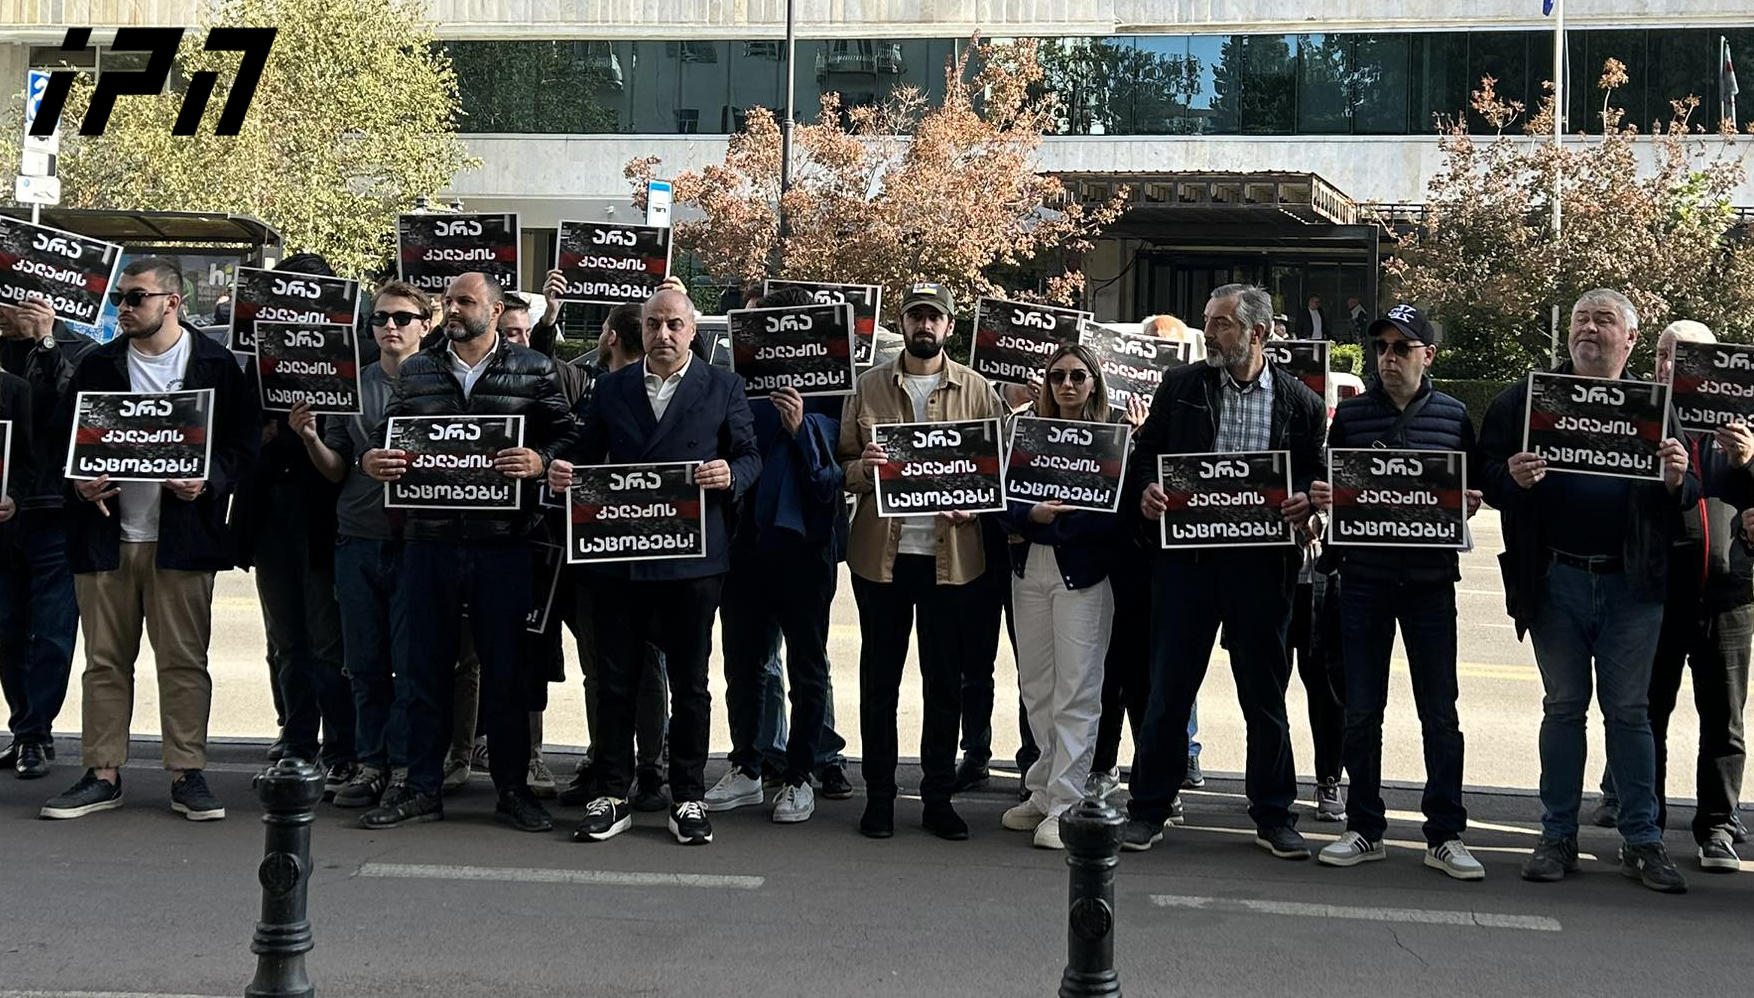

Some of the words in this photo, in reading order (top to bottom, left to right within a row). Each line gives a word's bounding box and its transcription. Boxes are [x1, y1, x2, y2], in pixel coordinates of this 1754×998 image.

[434, 220, 483, 237] არა
[592, 229, 637, 247] არა
[32, 232, 83, 259] არა
[423, 248, 496, 261] კალაძის
[12, 258, 87, 287] კალაძის
[578, 255, 647, 272] კალაძის
[271, 278, 321, 299] არა
[765, 314, 813, 333] არა
[1011, 309, 1057, 331] არა
[284, 330, 325, 348] არა
[1112, 335, 1158, 359] არა
[755, 343, 828, 360] კალაძის
[275, 360, 337, 375] კალაძის
[266, 388, 353, 406] საცობებს!
[1571, 384, 1626, 407] არა
[119, 400, 173, 417] არა
[101, 428, 184, 444] კალაძის
[428, 423, 481, 441] არა
[1554, 416, 1638, 437] კალაძის
[912, 430, 962, 449] არა
[1047, 426, 1093, 447] არა
[79, 457, 198, 474] საცობებს!
[411, 453, 494, 469] კალაძის
[1030, 454, 1101, 474] კალაძის
[1370, 457, 1424, 477] არა
[1535, 445, 1653, 470] საცობებს!
[900, 459, 977, 477] კალაძის
[1199, 460, 1250, 480] არა
[608, 471, 662, 491] არა
[396, 482, 509, 501] საცობებს!
[887, 488, 995, 508] საცობებს!
[1009, 479, 1111, 503] საცობებს!
[1187, 491, 1265, 507] კალაძის
[1356, 488, 1438, 506] კალაძის
[595, 503, 677, 520] კალაძის
[1172, 521, 1283, 540] საცობებს!
[1340, 519, 1455, 539] საცობებს!
[579, 533, 695, 554] საცობებს!
